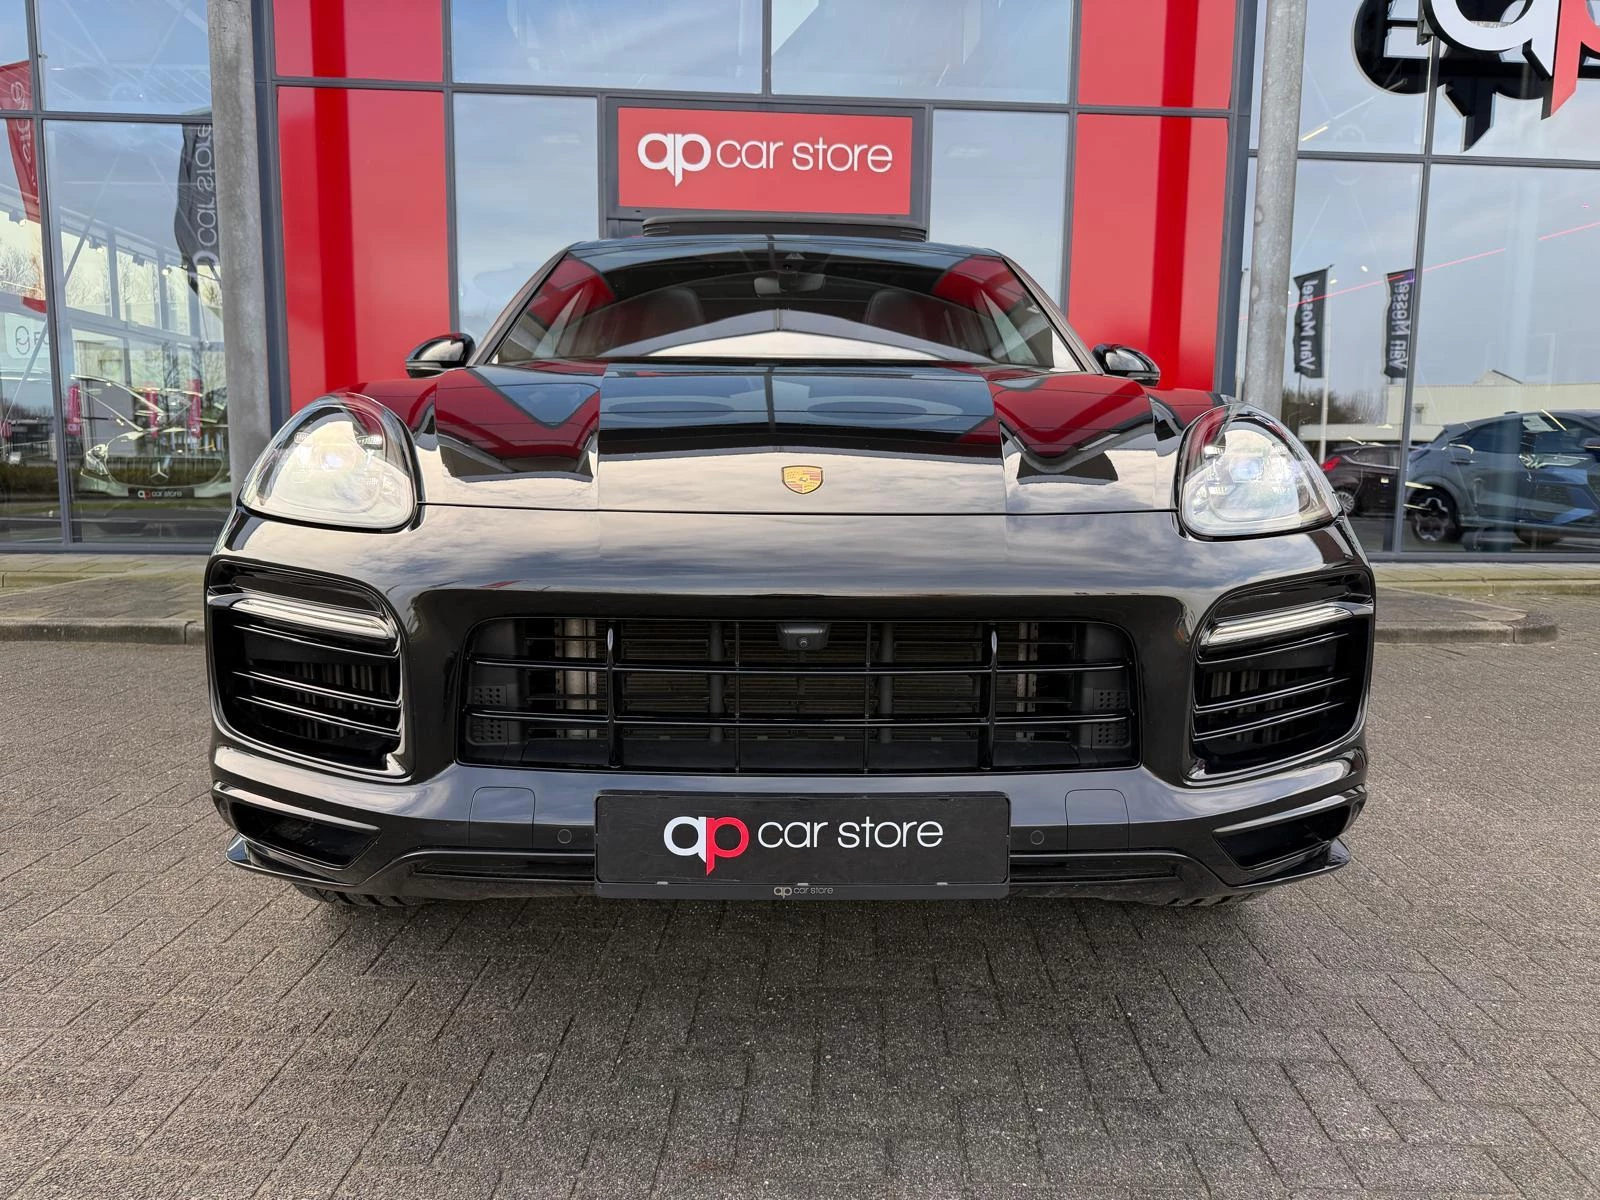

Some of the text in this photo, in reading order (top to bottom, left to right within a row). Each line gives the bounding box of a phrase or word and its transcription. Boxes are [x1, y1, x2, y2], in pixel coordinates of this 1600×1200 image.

[637, 132, 893, 188] ap car store
[663, 815, 944, 876] ap car store
[773, 886, 834, 900] ap car store
